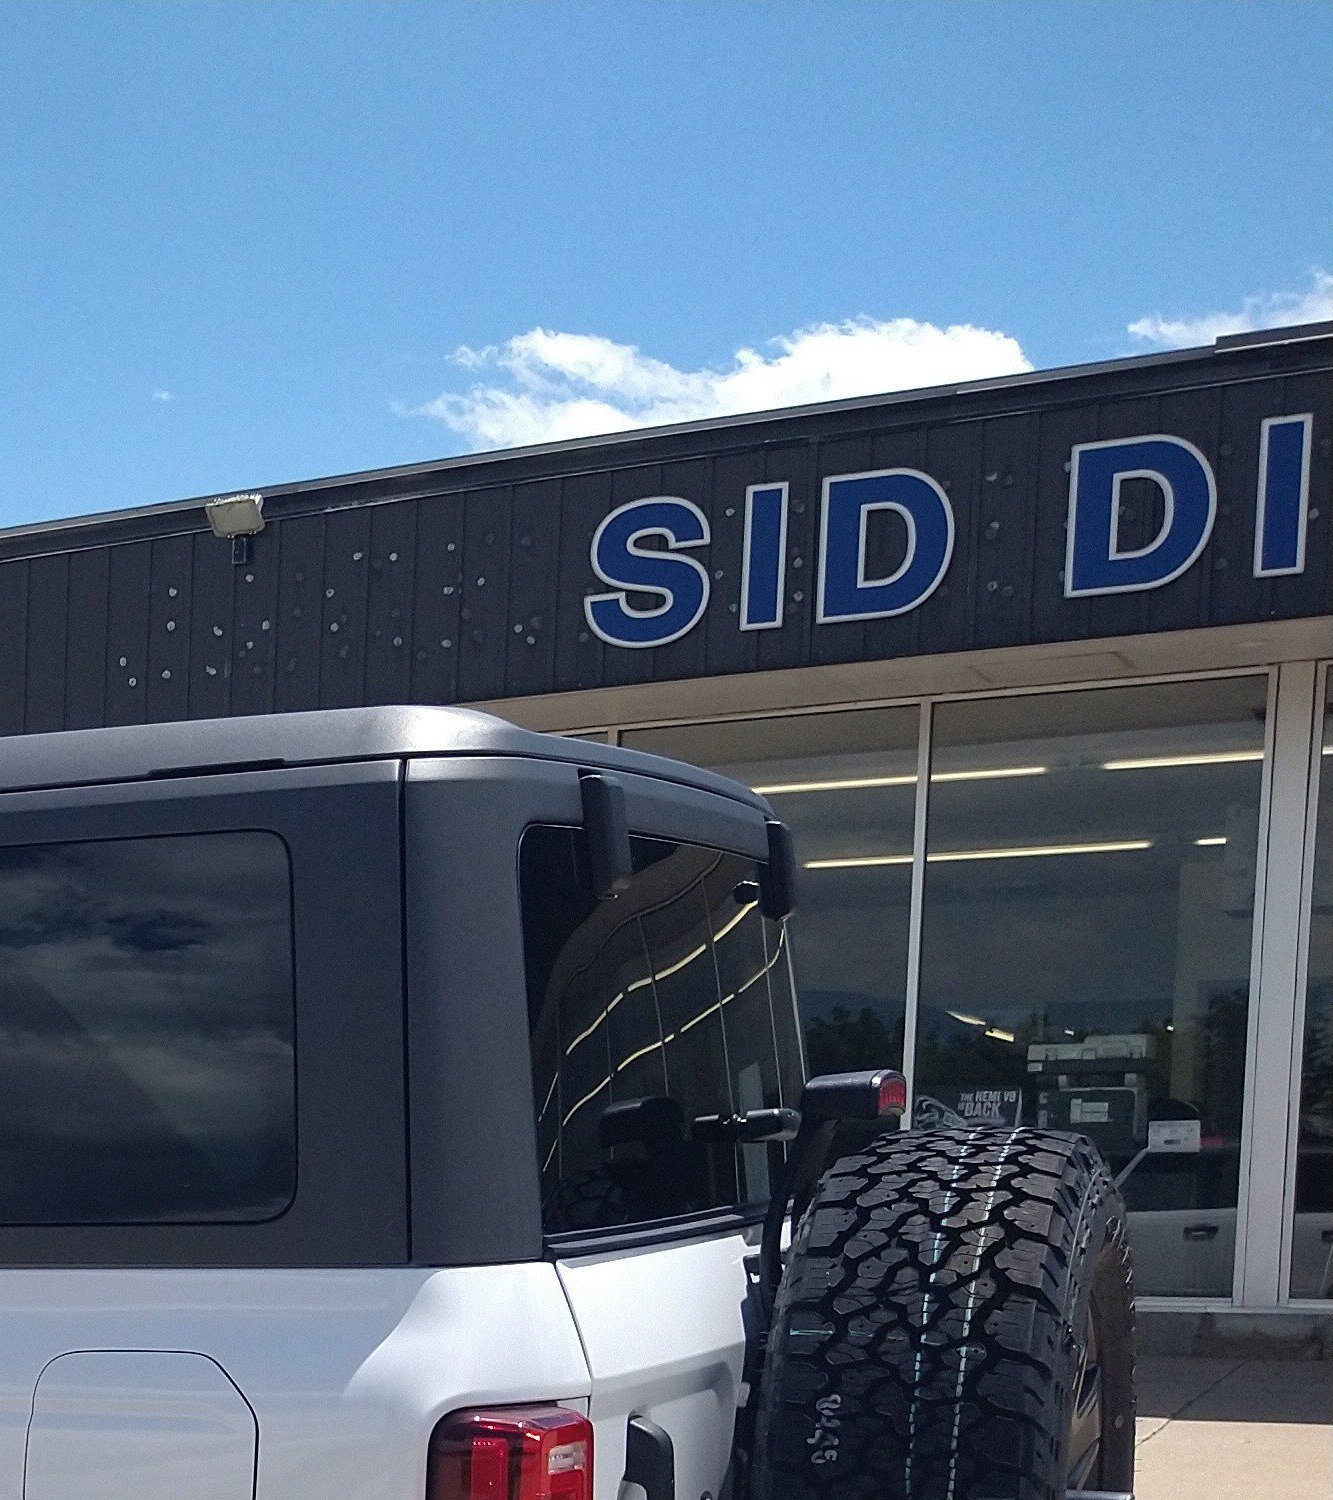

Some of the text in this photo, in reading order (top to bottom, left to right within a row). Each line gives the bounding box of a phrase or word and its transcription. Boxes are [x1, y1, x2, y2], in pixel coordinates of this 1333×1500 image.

[582, 412, 1314, 650] SID DI
[963, 1101, 1001, 1118] BACK
